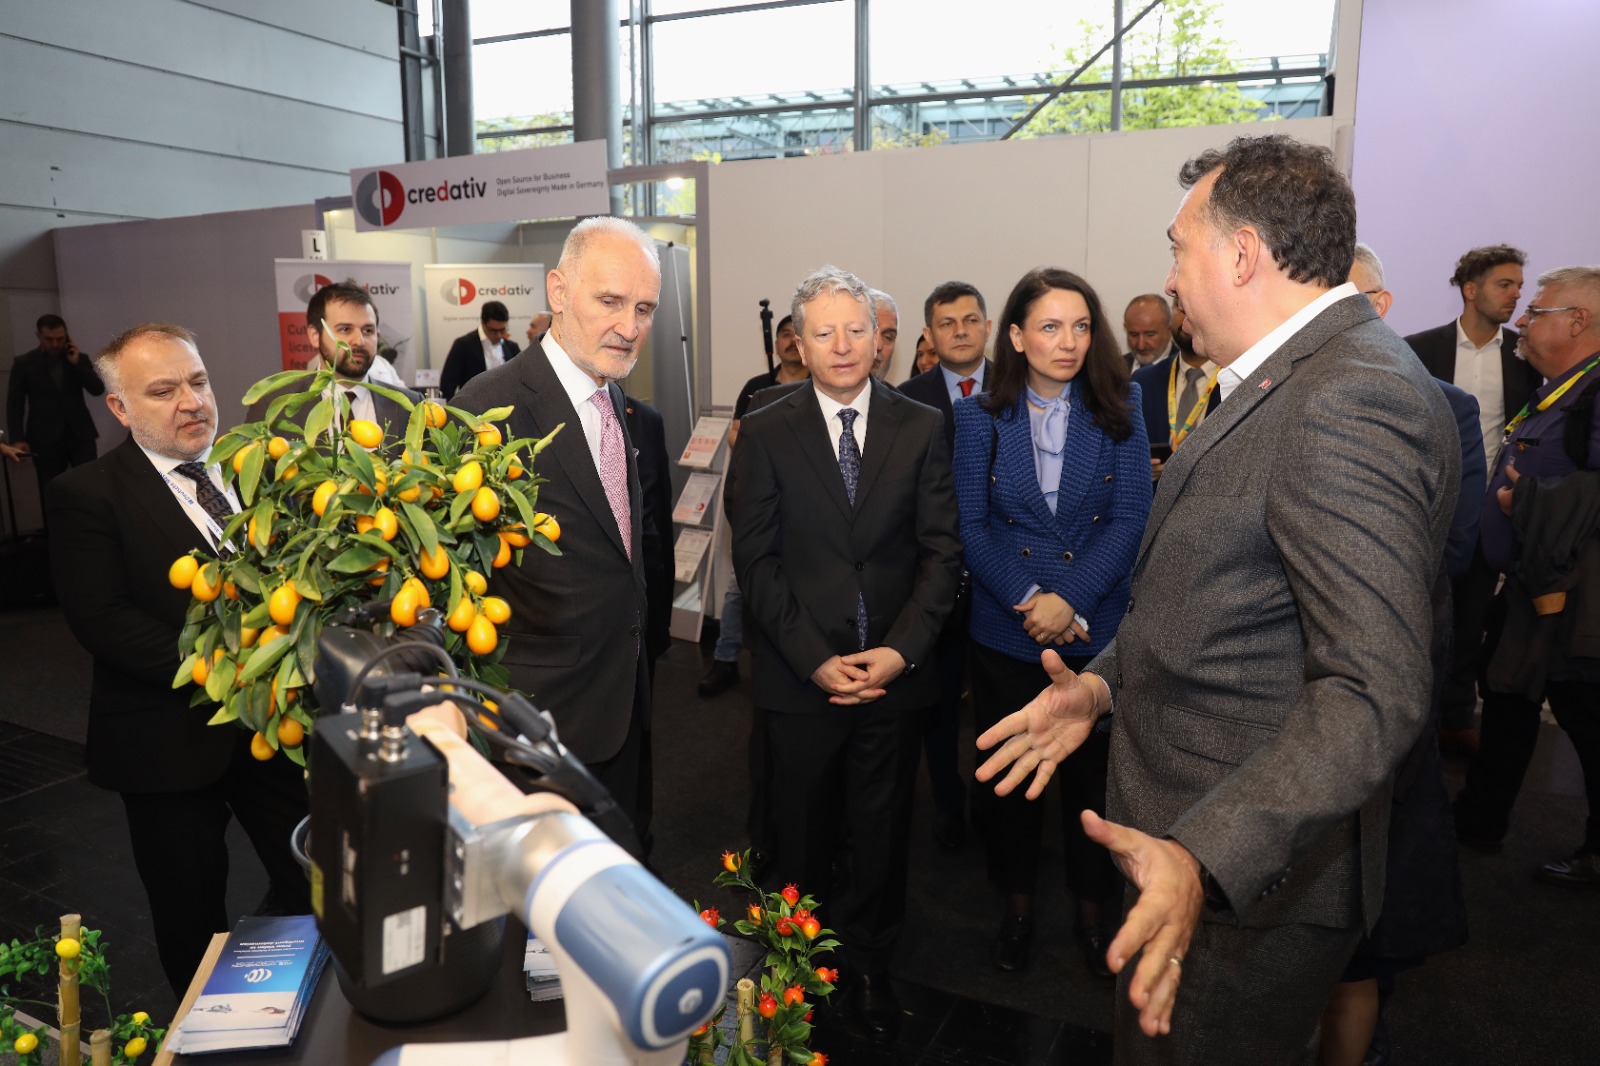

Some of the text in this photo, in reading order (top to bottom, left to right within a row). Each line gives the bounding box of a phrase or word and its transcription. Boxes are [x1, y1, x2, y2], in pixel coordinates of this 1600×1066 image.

[496, 172, 571, 186] Open Source for Business
[407, 177, 487, 204] credativ
[497, 180, 604, 198] Digital Sovereignty Made in Germany
[313, 238, 321, 252] L
[362, 283, 397, 295] dativ
[478, 285, 531, 296] credativ
